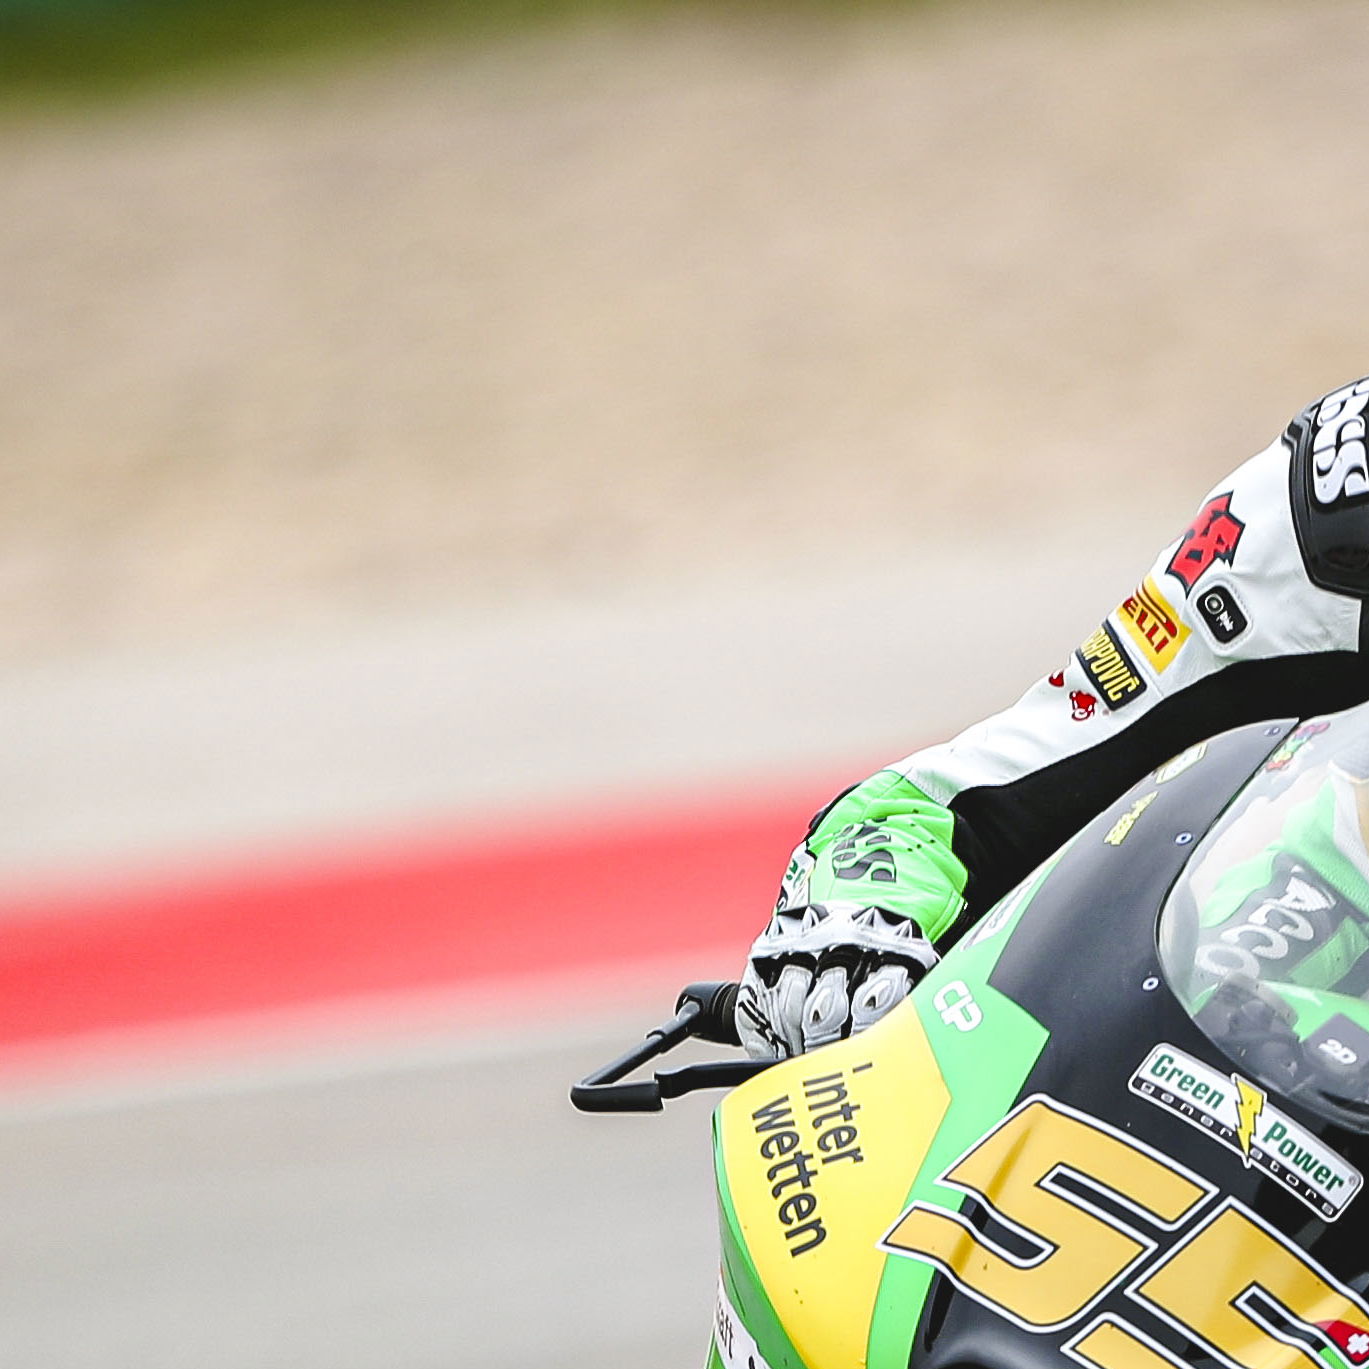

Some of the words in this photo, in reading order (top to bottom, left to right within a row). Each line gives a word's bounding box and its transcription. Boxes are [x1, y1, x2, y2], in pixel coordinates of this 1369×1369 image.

[752, 1094, 827, 1258] wetten
[802, 1062, 873, 1165] inter
[1150, 1053, 1225, 1111] Green
[1262, 1120, 1344, 1193] Power
